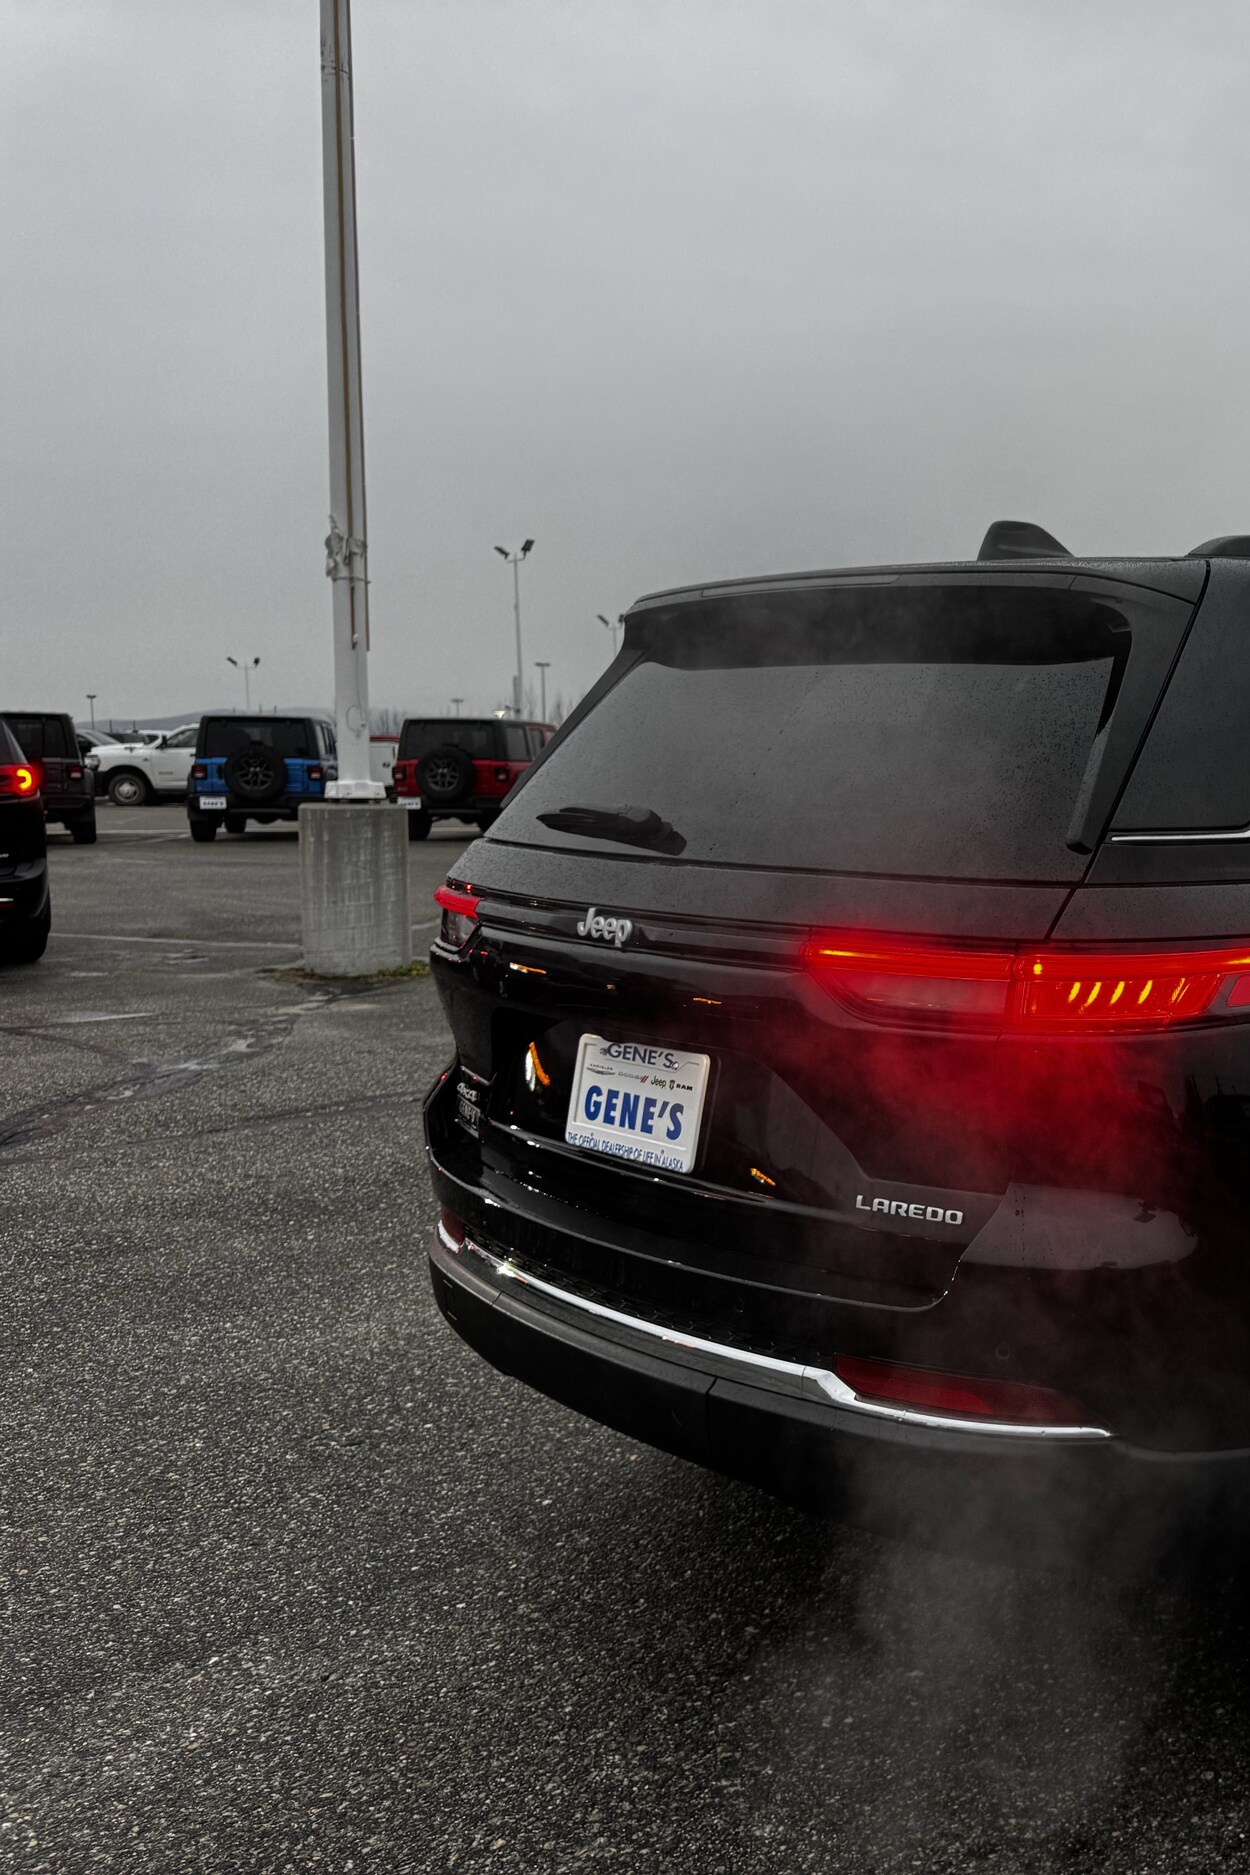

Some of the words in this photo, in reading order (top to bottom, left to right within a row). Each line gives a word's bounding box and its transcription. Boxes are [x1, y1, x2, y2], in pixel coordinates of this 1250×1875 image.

[577, 907, 632, 947] Jeep
[606, 1042, 676, 1069] GENE'S
[584, 1084, 685, 1141] GENE'S
[568, 1131, 578, 1146] THE
[633, 1147, 643, 1162] OF
[662, 1155, 684, 1172] ALASKA
[856, 1194, 963, 1225] LAREDO
